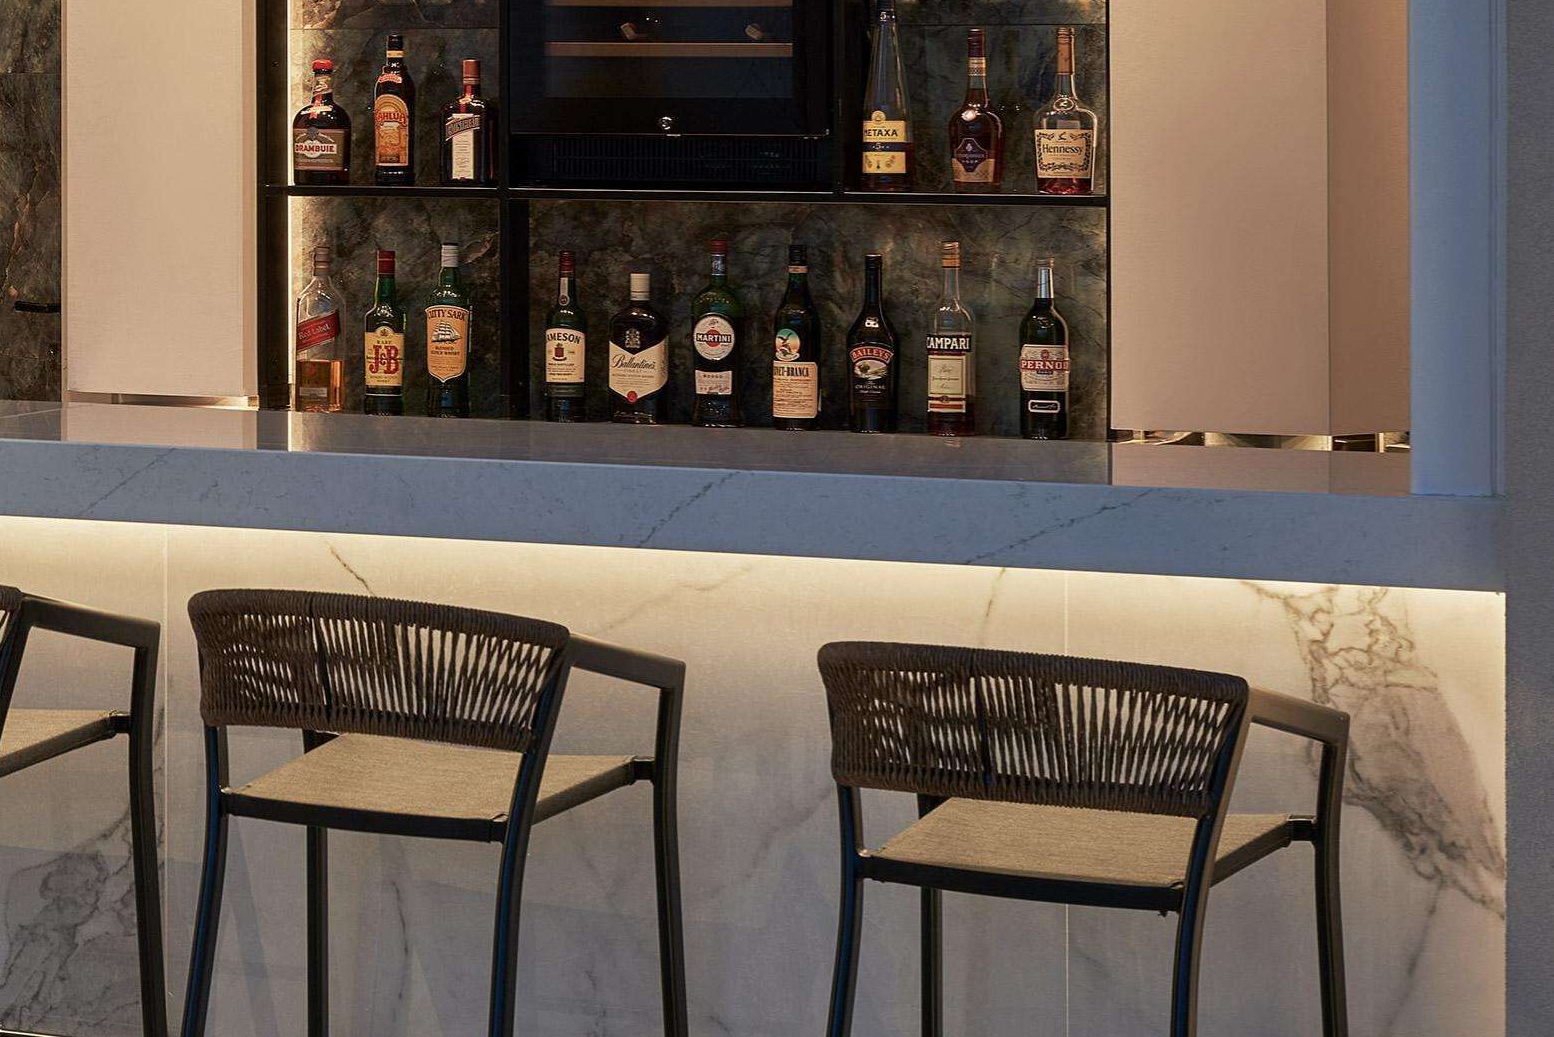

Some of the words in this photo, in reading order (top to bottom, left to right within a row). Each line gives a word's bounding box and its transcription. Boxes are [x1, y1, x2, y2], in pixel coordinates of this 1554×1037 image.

[295, 145, 335, 153] DRAMBUIE
[1042, 144, 1083, 156] Hennessy
[696, 333, 732, 343] MARTINI
[853, 347, 890, 360] BAILEYS
